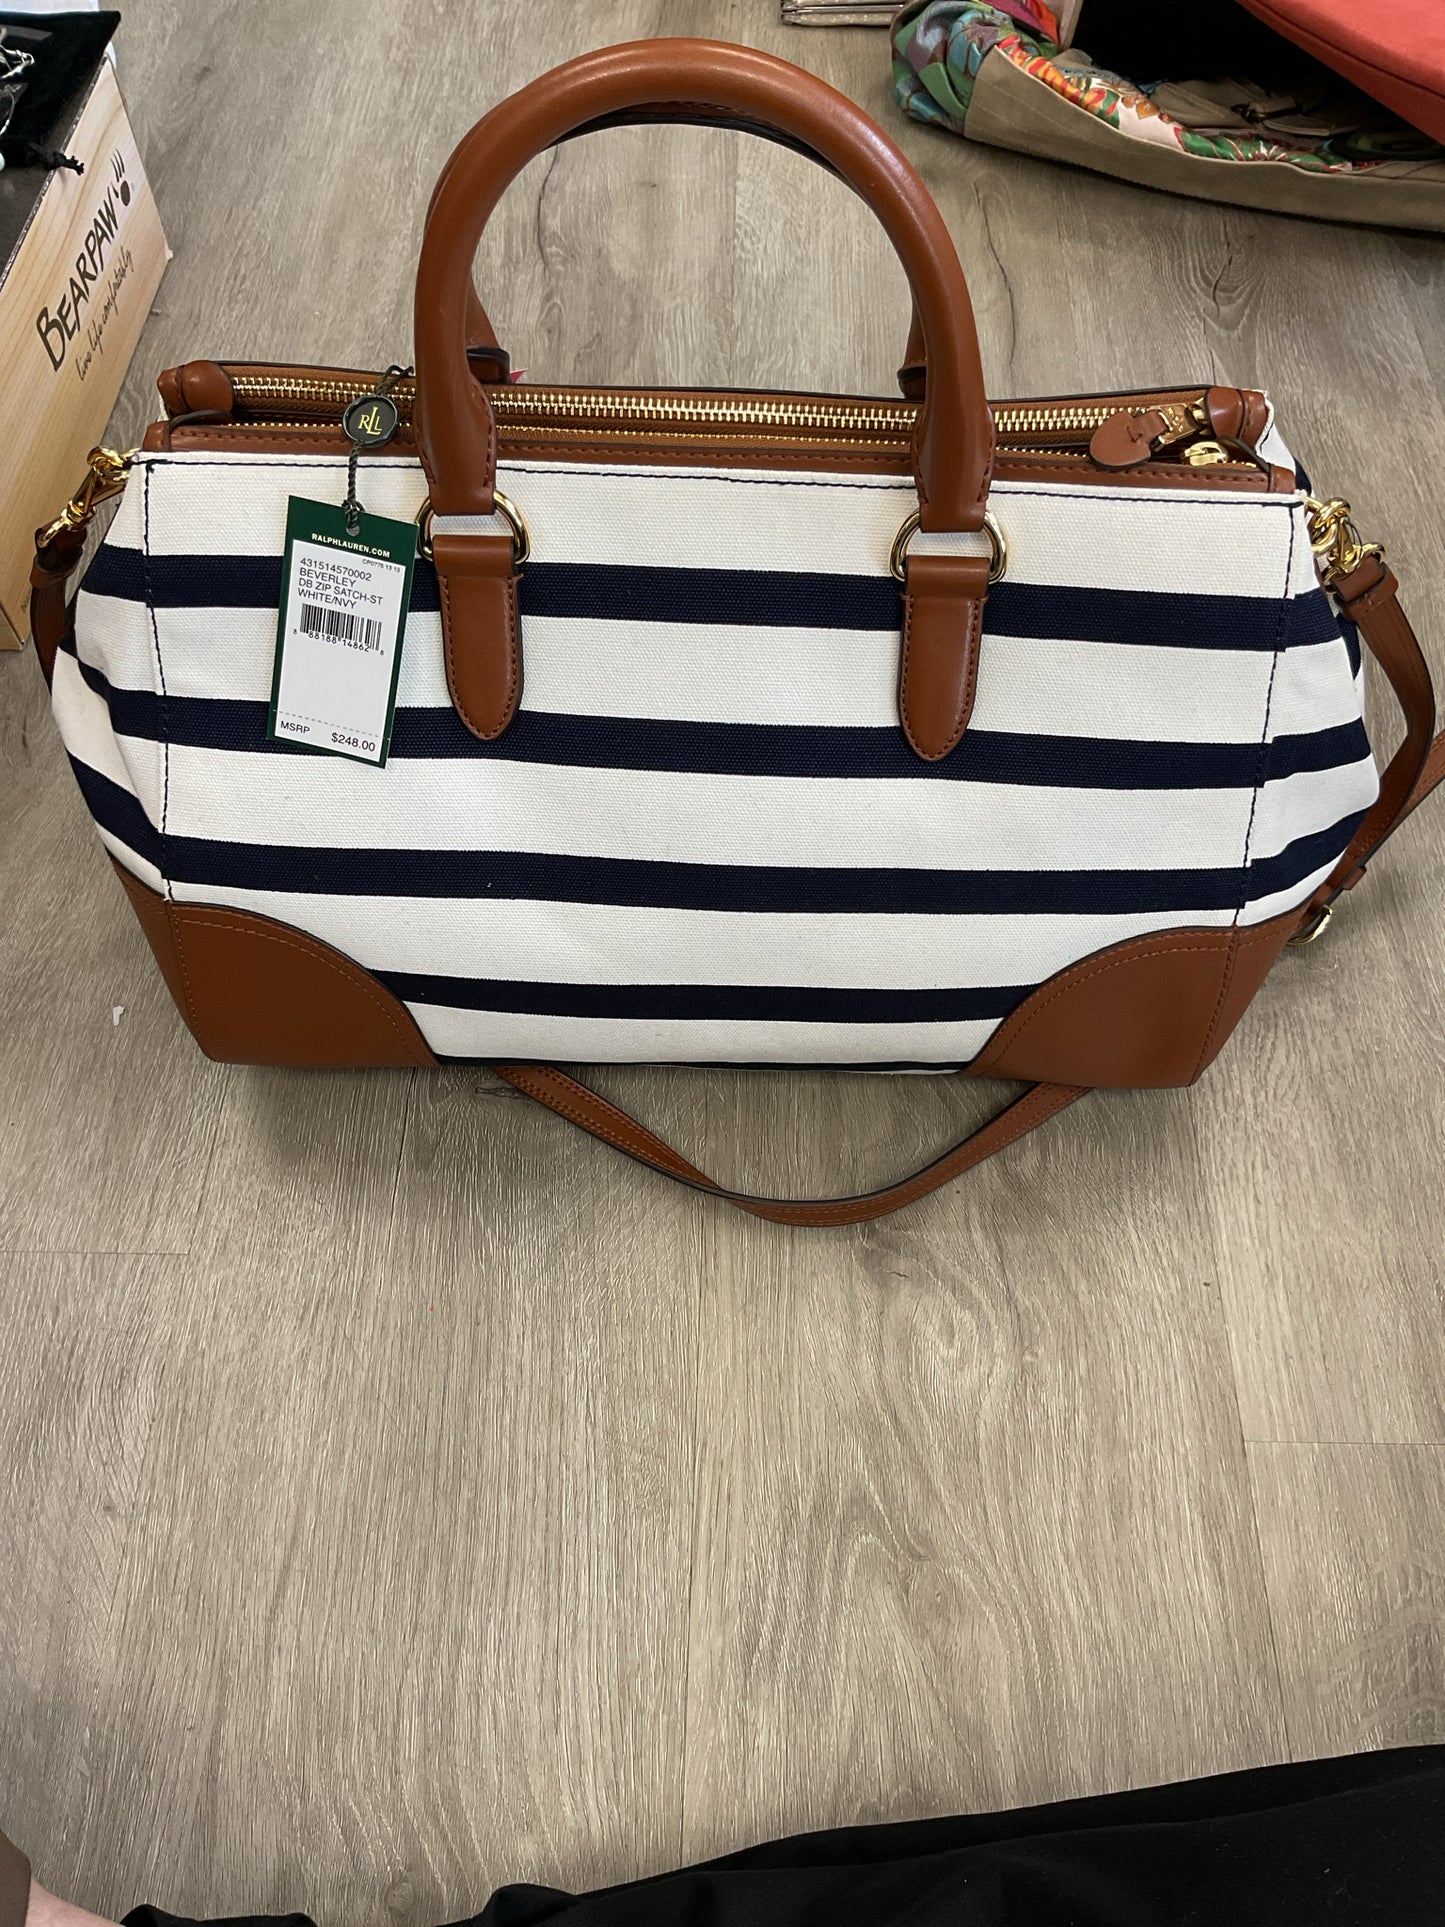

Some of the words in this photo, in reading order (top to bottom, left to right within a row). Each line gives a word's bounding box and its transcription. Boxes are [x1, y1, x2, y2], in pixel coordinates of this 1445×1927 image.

[36, 185, 118, 372] BEARPAW
[87, 319, 104, 355] life
[311, 533, 390, 558] RALPHLAUREN.COM
[299, 567, 356, 588] BEVERLEY
[300, 557, 372, 582] 431514570002
[297, 587, 357, 609] WHITE/NVY
[298, 577, 313, 588] DB
[315, 582, 332, 592] ZIP
[333, 585, 384, 606] SATCH-ST
[342, 638, 371, 653] 14862
[280, 720, 311, 734] MSRP
[331, 732, 376, 752] $248.00
